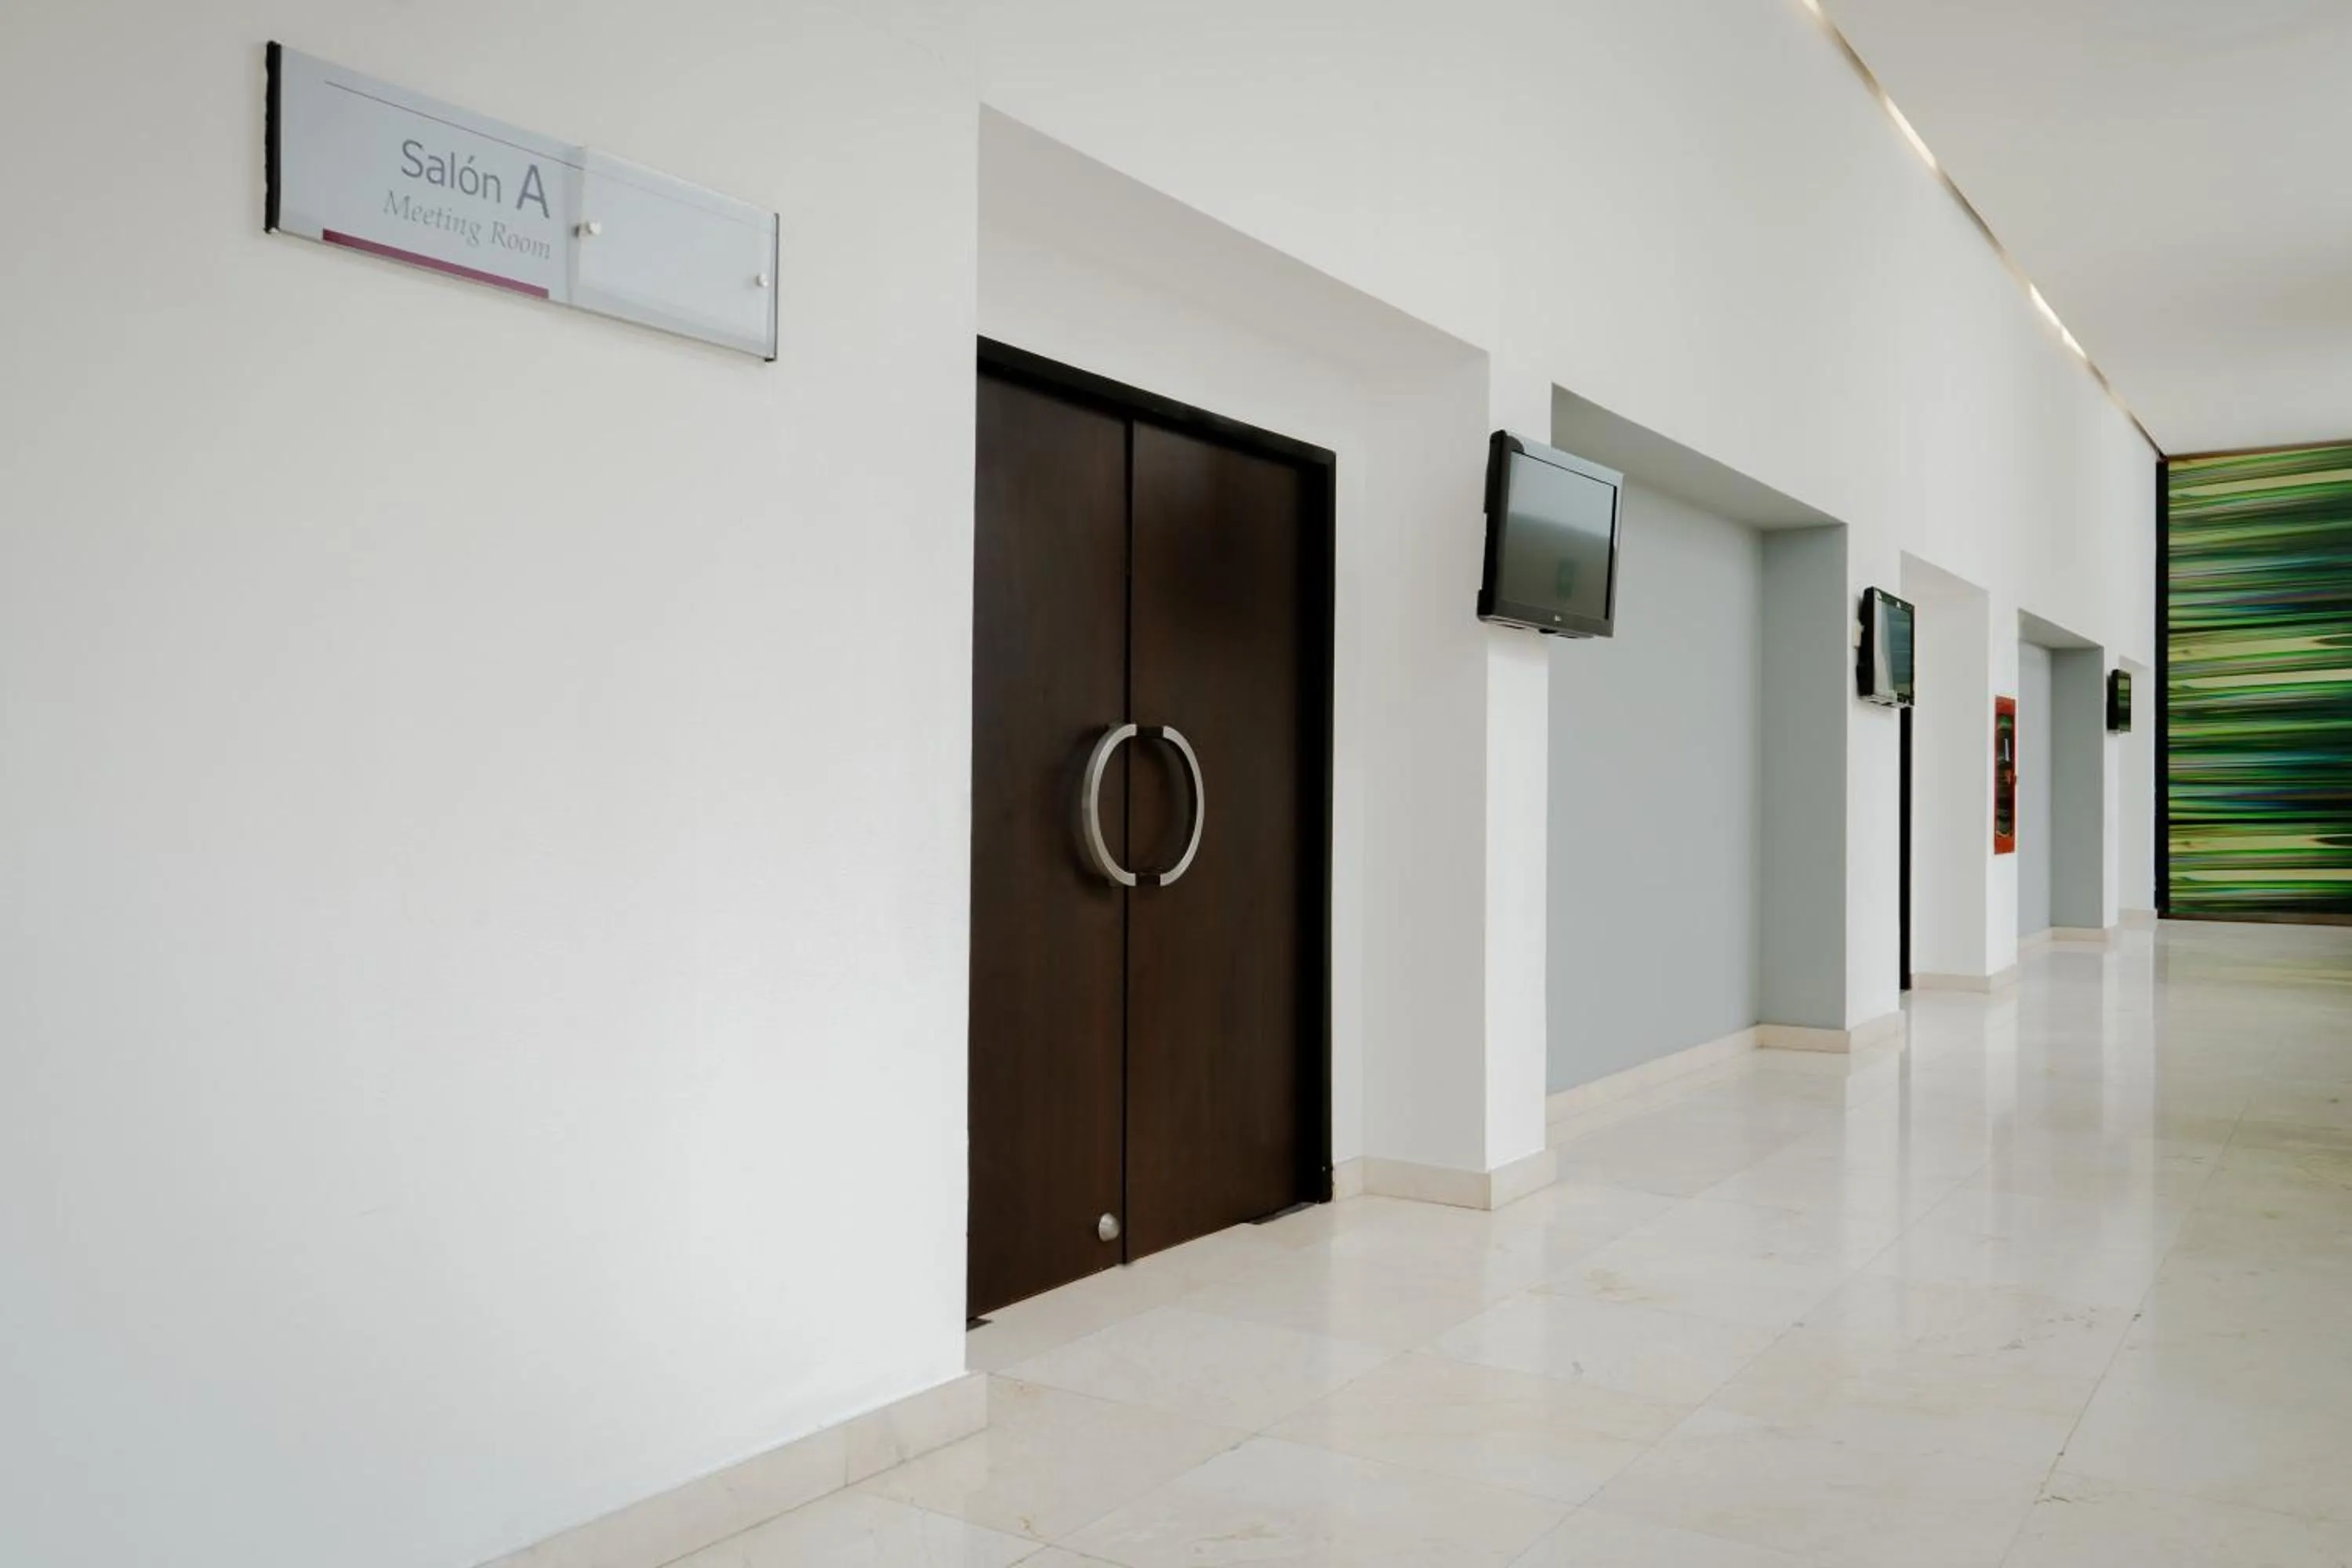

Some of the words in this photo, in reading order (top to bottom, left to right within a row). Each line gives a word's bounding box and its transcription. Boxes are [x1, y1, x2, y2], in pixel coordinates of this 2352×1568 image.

[401, 139, 501, 203] Salón
[515, 164, 550, 219] A
[383, 190, 481, 247] Meeting
[490, 220, 550, 260] Room
